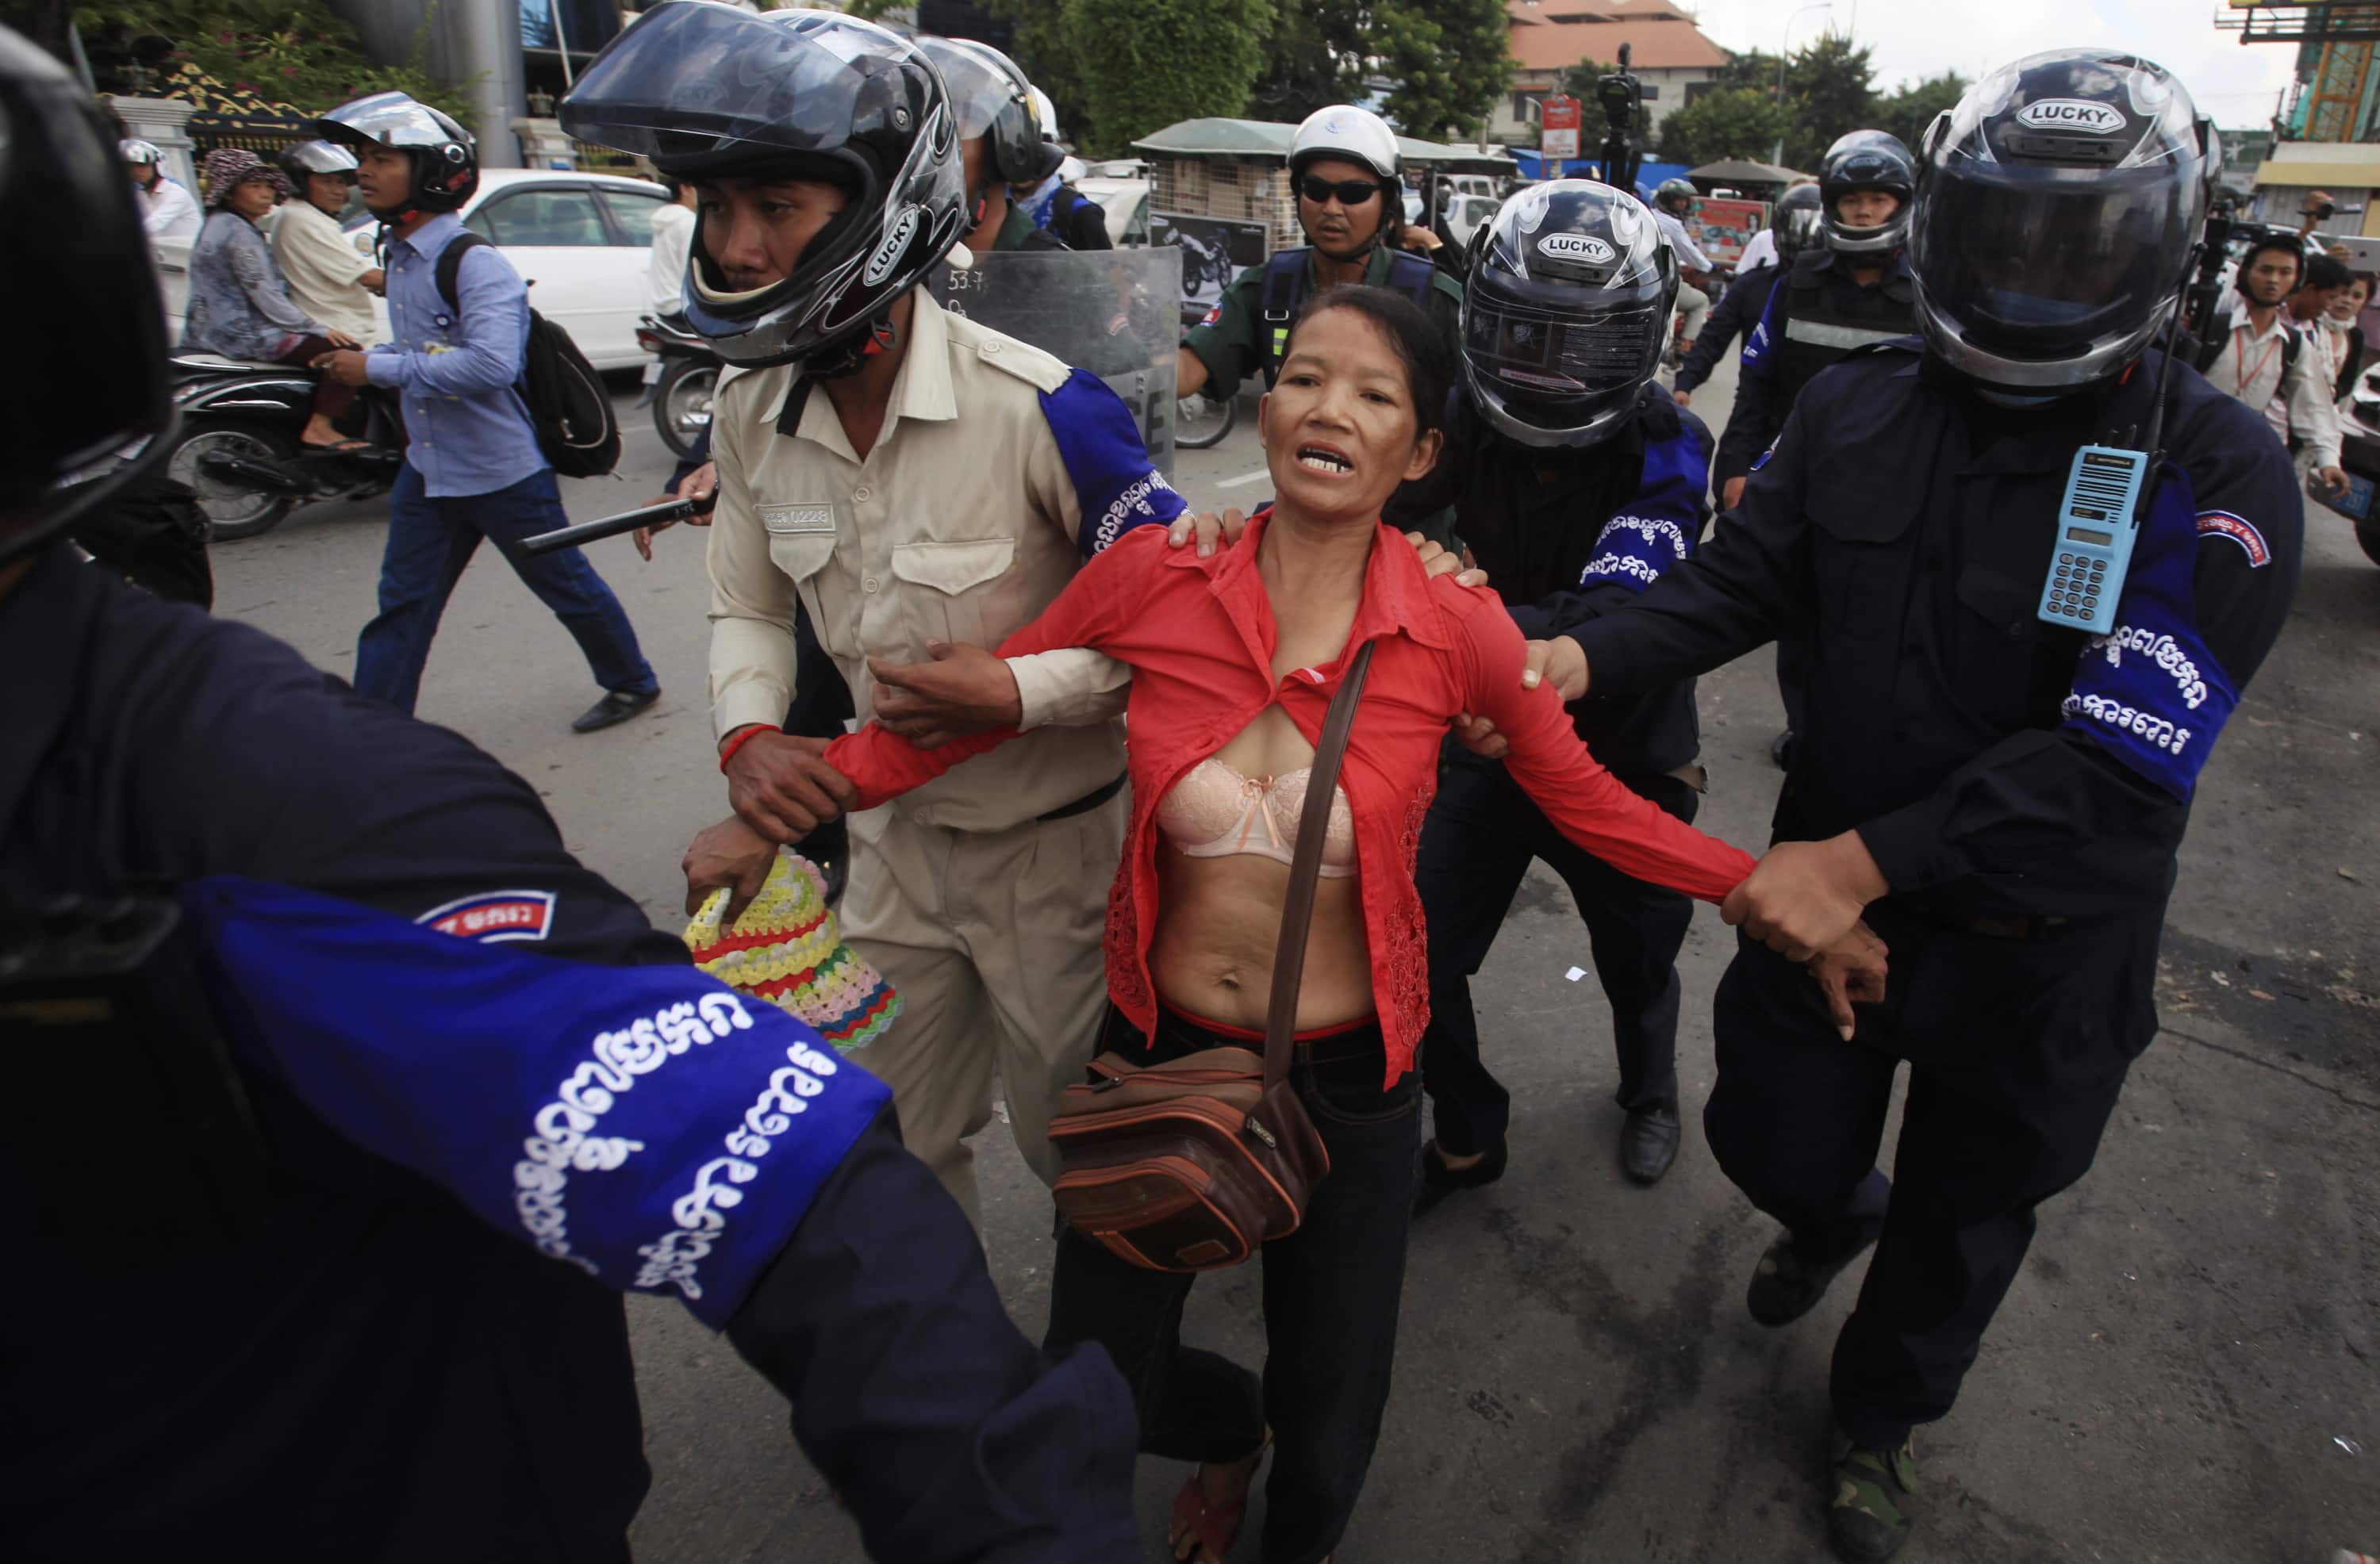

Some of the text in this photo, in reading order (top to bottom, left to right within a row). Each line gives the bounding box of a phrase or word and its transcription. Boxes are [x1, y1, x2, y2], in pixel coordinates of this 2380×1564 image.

[2032, 106, 2109, 124] LUCKY
[871, 217, 914, 278] LUCKY
[1549, 240, 1603, 255] LUCKY
